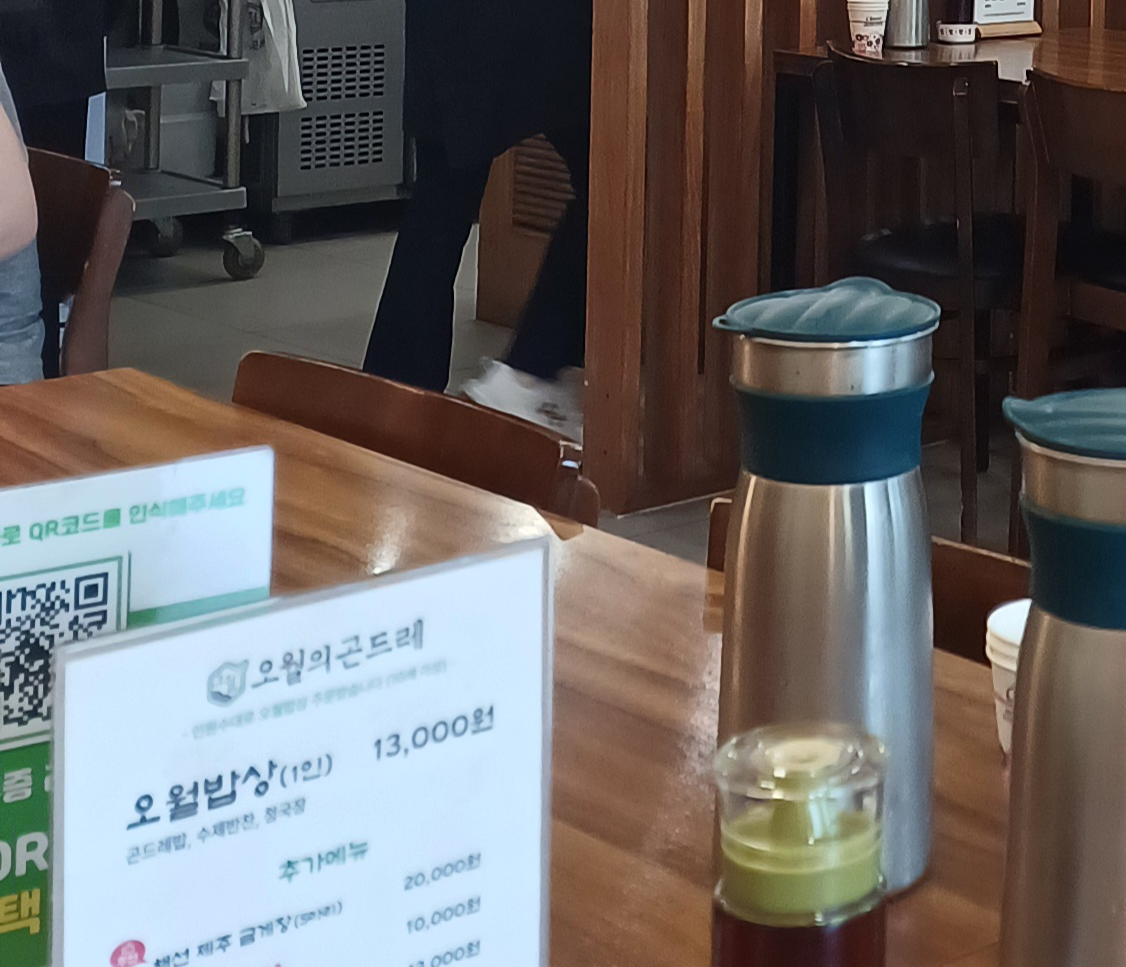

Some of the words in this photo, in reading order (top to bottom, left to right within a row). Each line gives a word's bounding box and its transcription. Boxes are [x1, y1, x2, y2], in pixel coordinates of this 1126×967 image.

[29, 508, 121, 542] QR코드를
[374, 705, 495, 760] 13,000원
[278, 838, 371, 884] 추가메뉴
[196, 933, 233, 958] 제주
